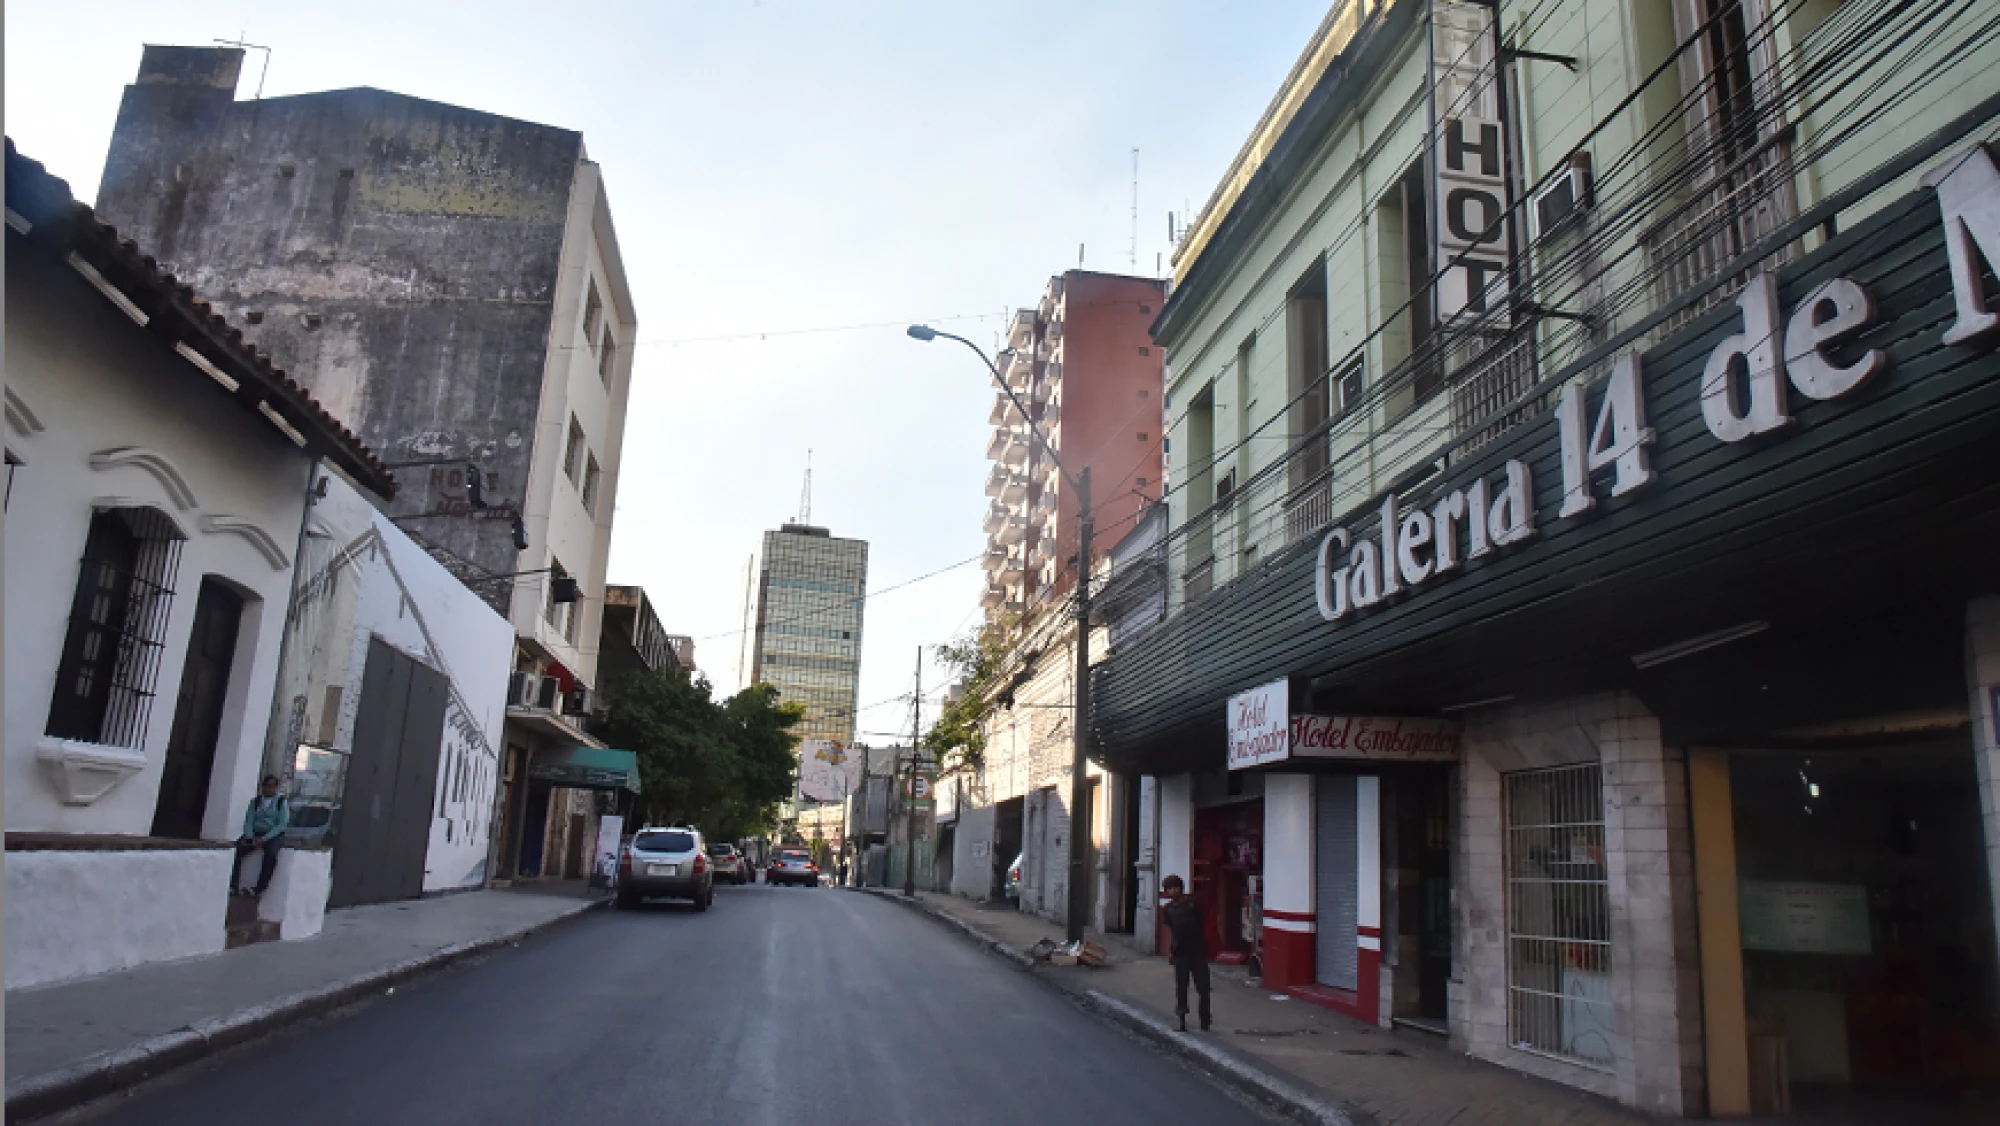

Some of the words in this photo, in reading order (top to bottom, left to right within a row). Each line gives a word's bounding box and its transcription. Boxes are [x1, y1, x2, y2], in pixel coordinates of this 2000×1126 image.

[1446, 119, 1503, 313] HOT
[1555, 351, 1657, 518] 14
[1701, 270, 1886, 441] de
[1237, 694, 1268, 731] Hotel
[1291, 716, 1352, 750] Hotel
[1354, 718, 1459, 755] Embajador
